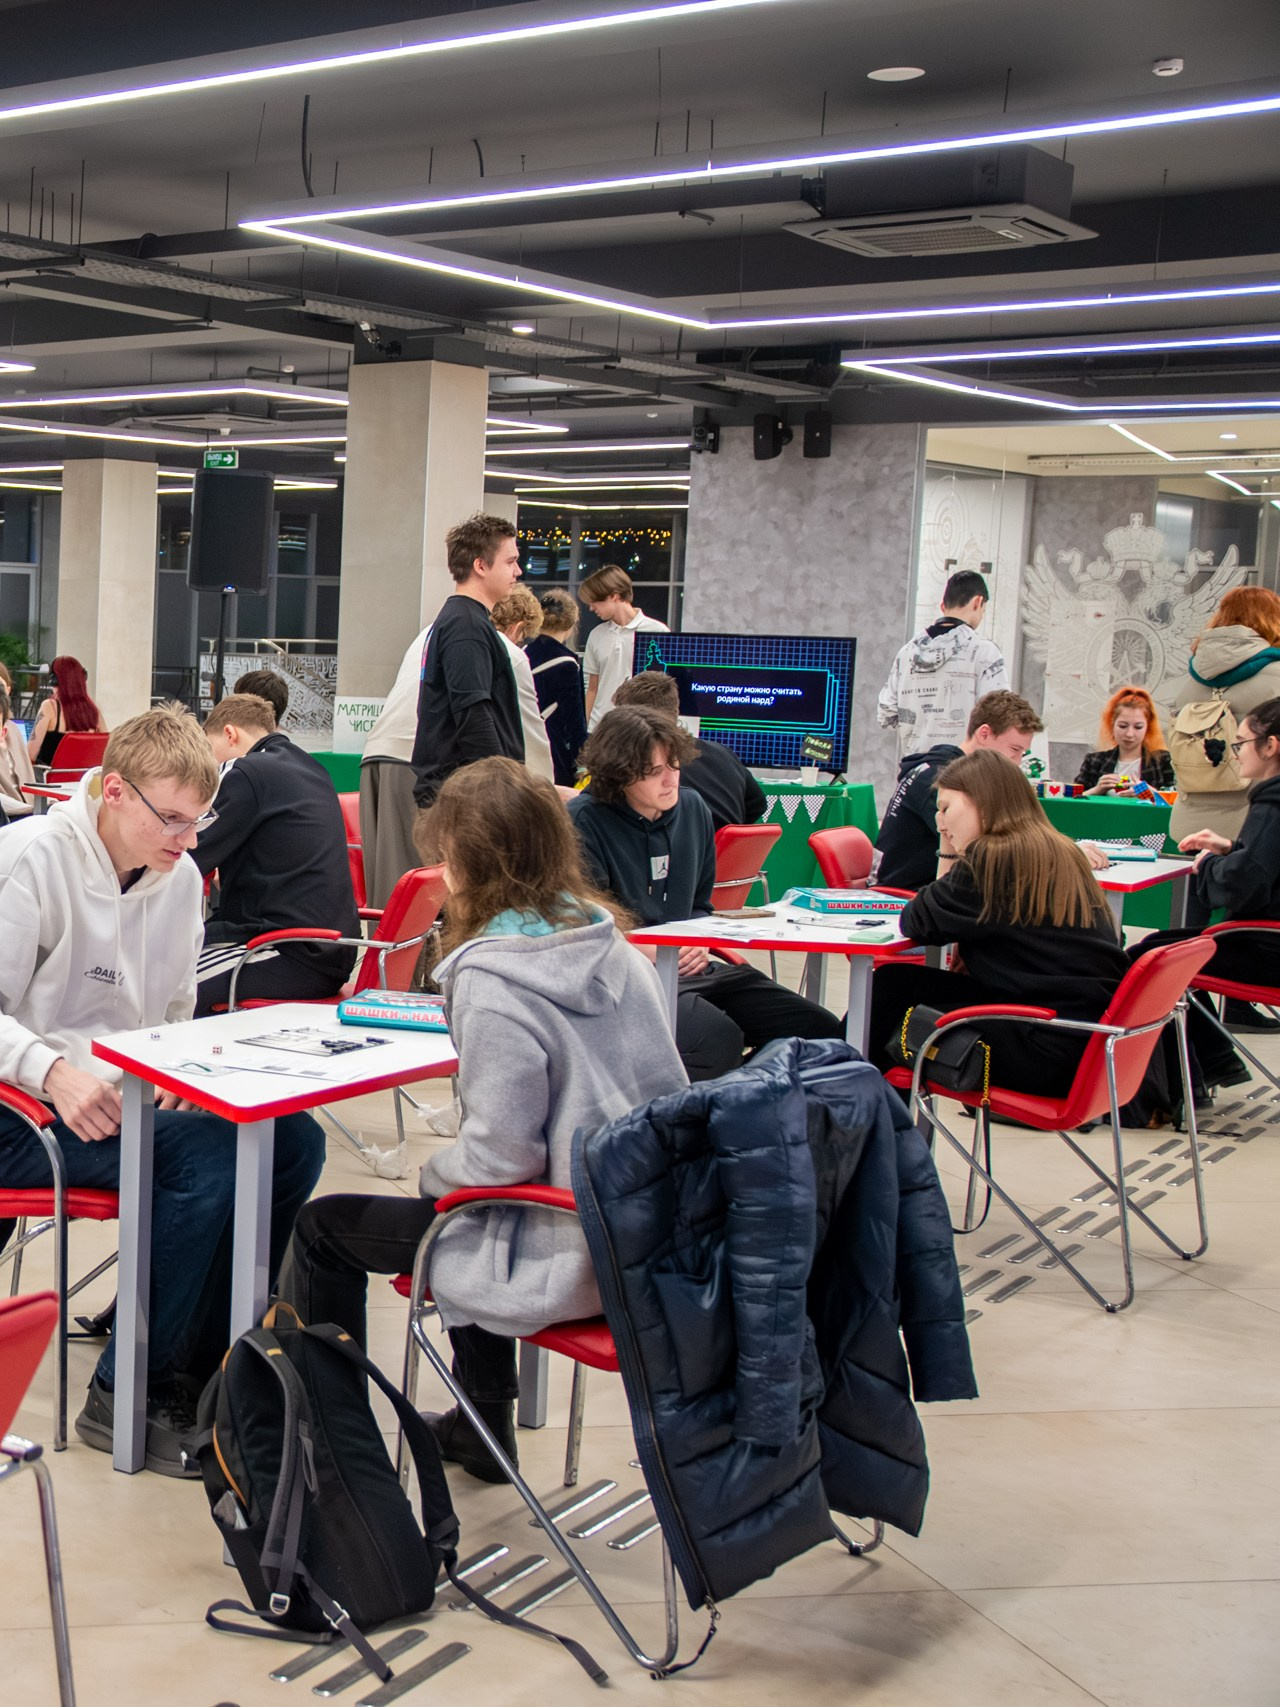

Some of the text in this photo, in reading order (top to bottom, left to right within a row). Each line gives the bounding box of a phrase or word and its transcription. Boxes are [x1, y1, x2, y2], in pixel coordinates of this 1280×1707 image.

[691, 683, 802, 696] Какую страну можно считать
[717, 695, 775, 705] родиной нард?
[349, 719, 376, 732] ЧИСЕ
[827, 902, 863, 910] ШАШКИ
[345, 1006, 399, 1020] ШАШКИ
[412, 1012, 448, 1026] НАРД
